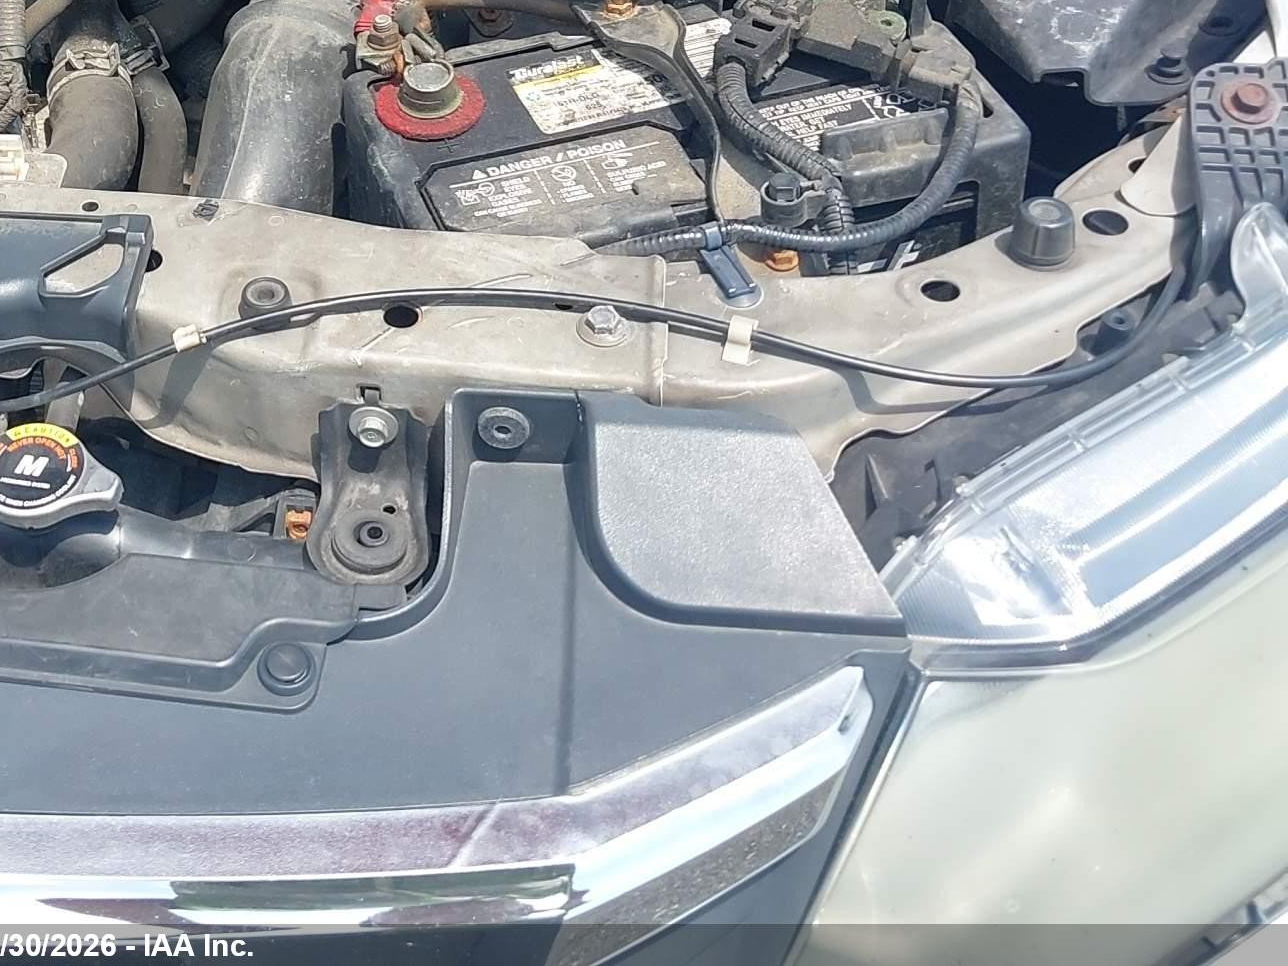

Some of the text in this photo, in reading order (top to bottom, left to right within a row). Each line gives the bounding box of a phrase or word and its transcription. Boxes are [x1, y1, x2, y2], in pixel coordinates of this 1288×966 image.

[779, 116, 801, 125] EYES
[800, 103, 852, 121] IMMEDIATELY
[486, 156, 552, 176] DANGER
[567, 139, 626, 159] POISON
[500, 176, 530, 187] SHIELD
[7, 437, 34, 453] NEVER
[35, 437, 57, 449] OPEN
[14, 454, 50, 477] M
